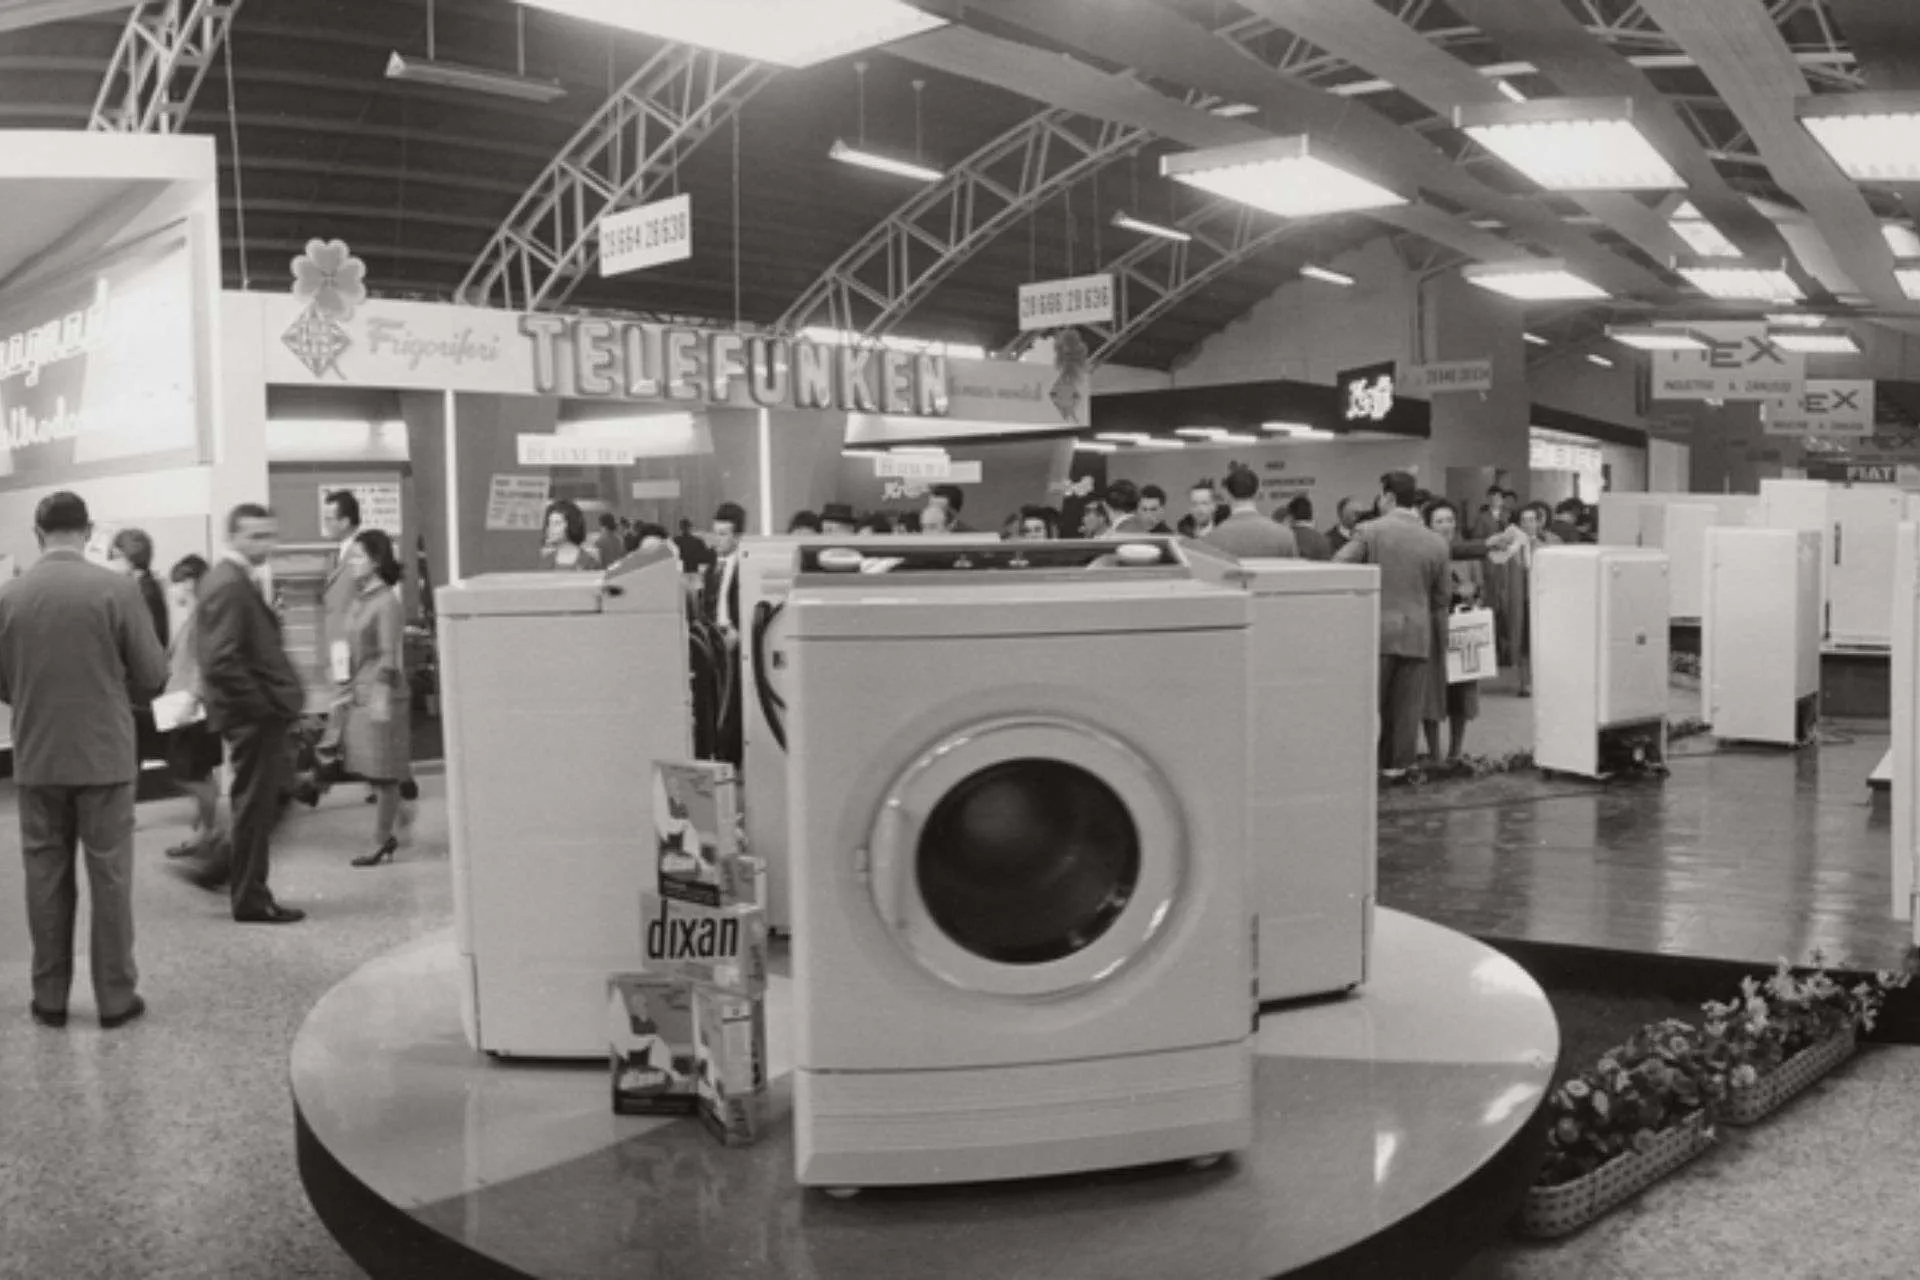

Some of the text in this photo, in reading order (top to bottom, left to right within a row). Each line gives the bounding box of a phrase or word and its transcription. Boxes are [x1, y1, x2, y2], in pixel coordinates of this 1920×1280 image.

[367, 316, 500, 371] Frigoriferi
[518, 312, 950, 416] TELEFUNKEN
[648, 899, 738, 960] dixan
